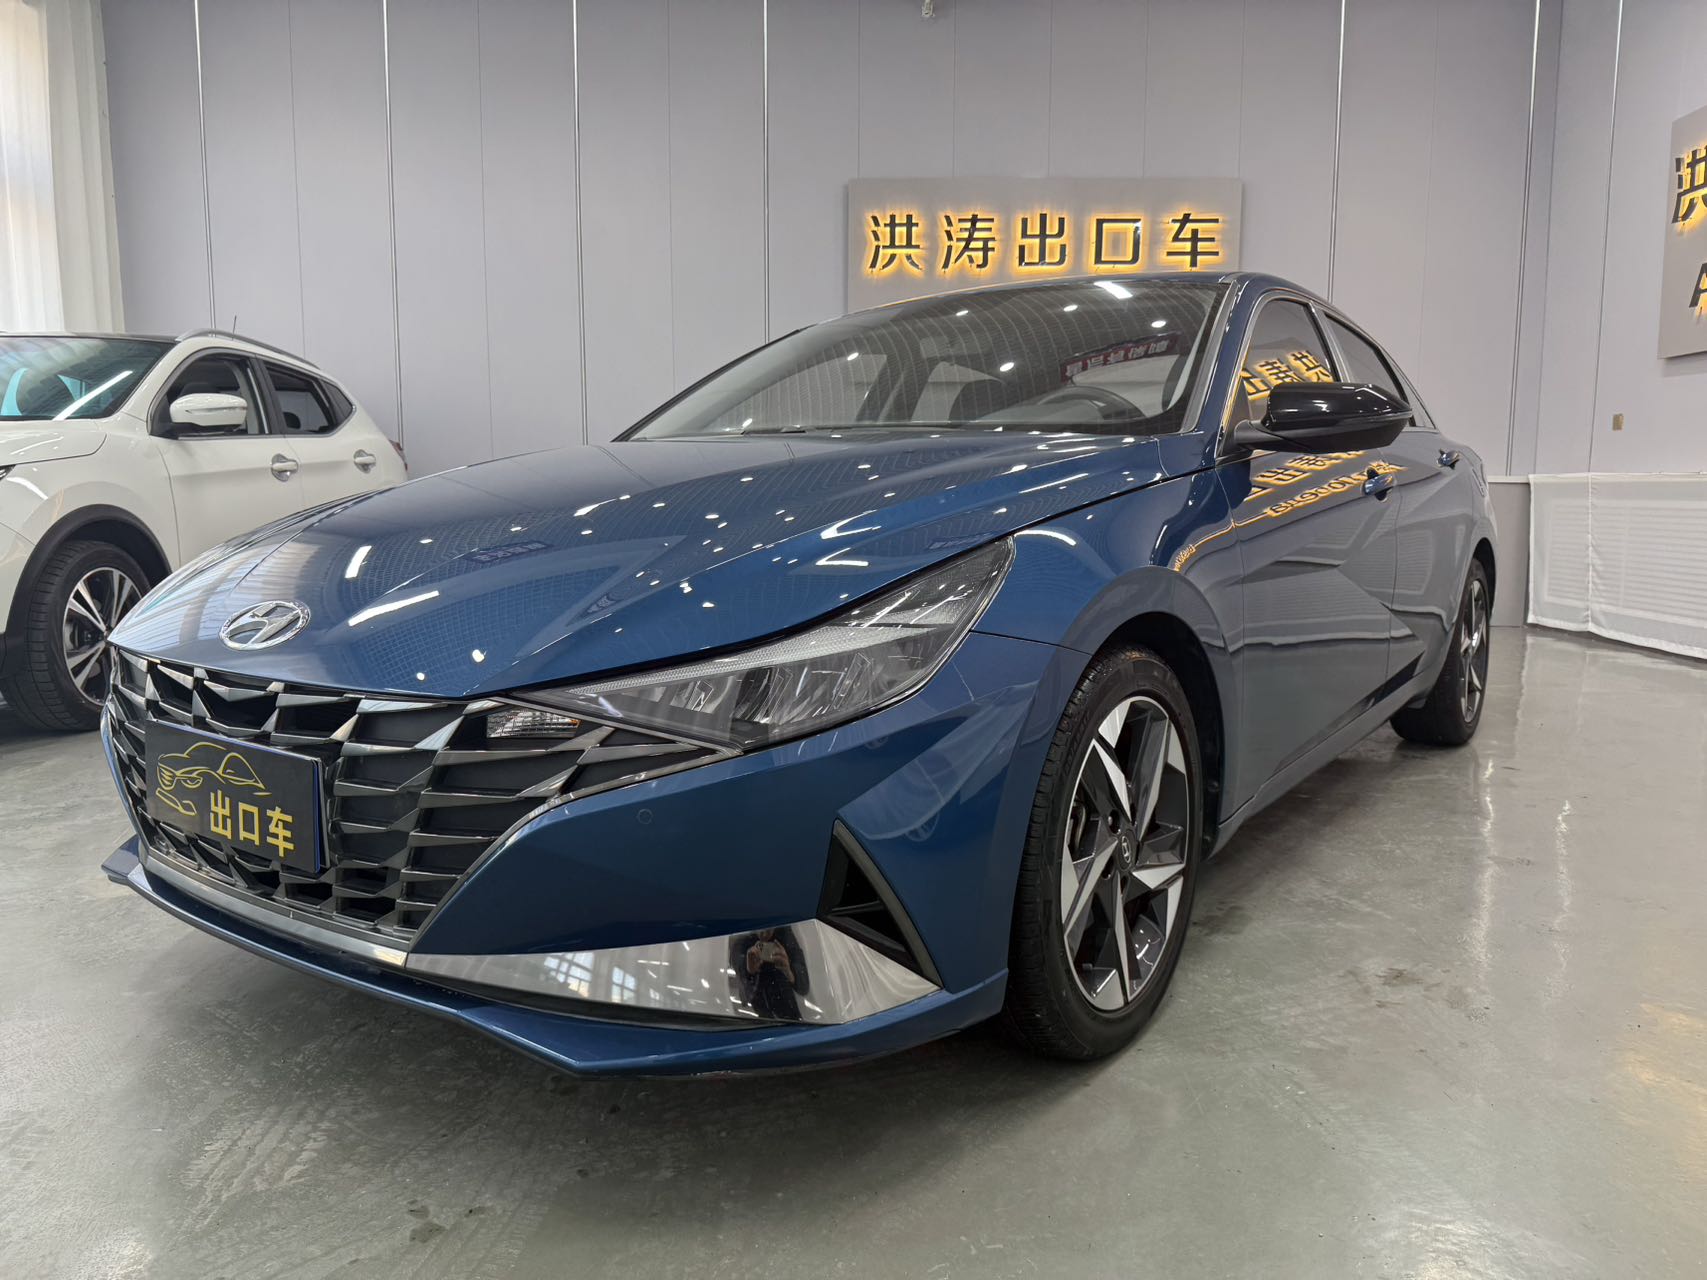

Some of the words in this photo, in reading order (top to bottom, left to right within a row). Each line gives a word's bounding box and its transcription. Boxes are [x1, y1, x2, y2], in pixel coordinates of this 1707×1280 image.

[868, 212, 1221, 271] 洪涛出口车
[210, 790, 295, 858] 出口车
